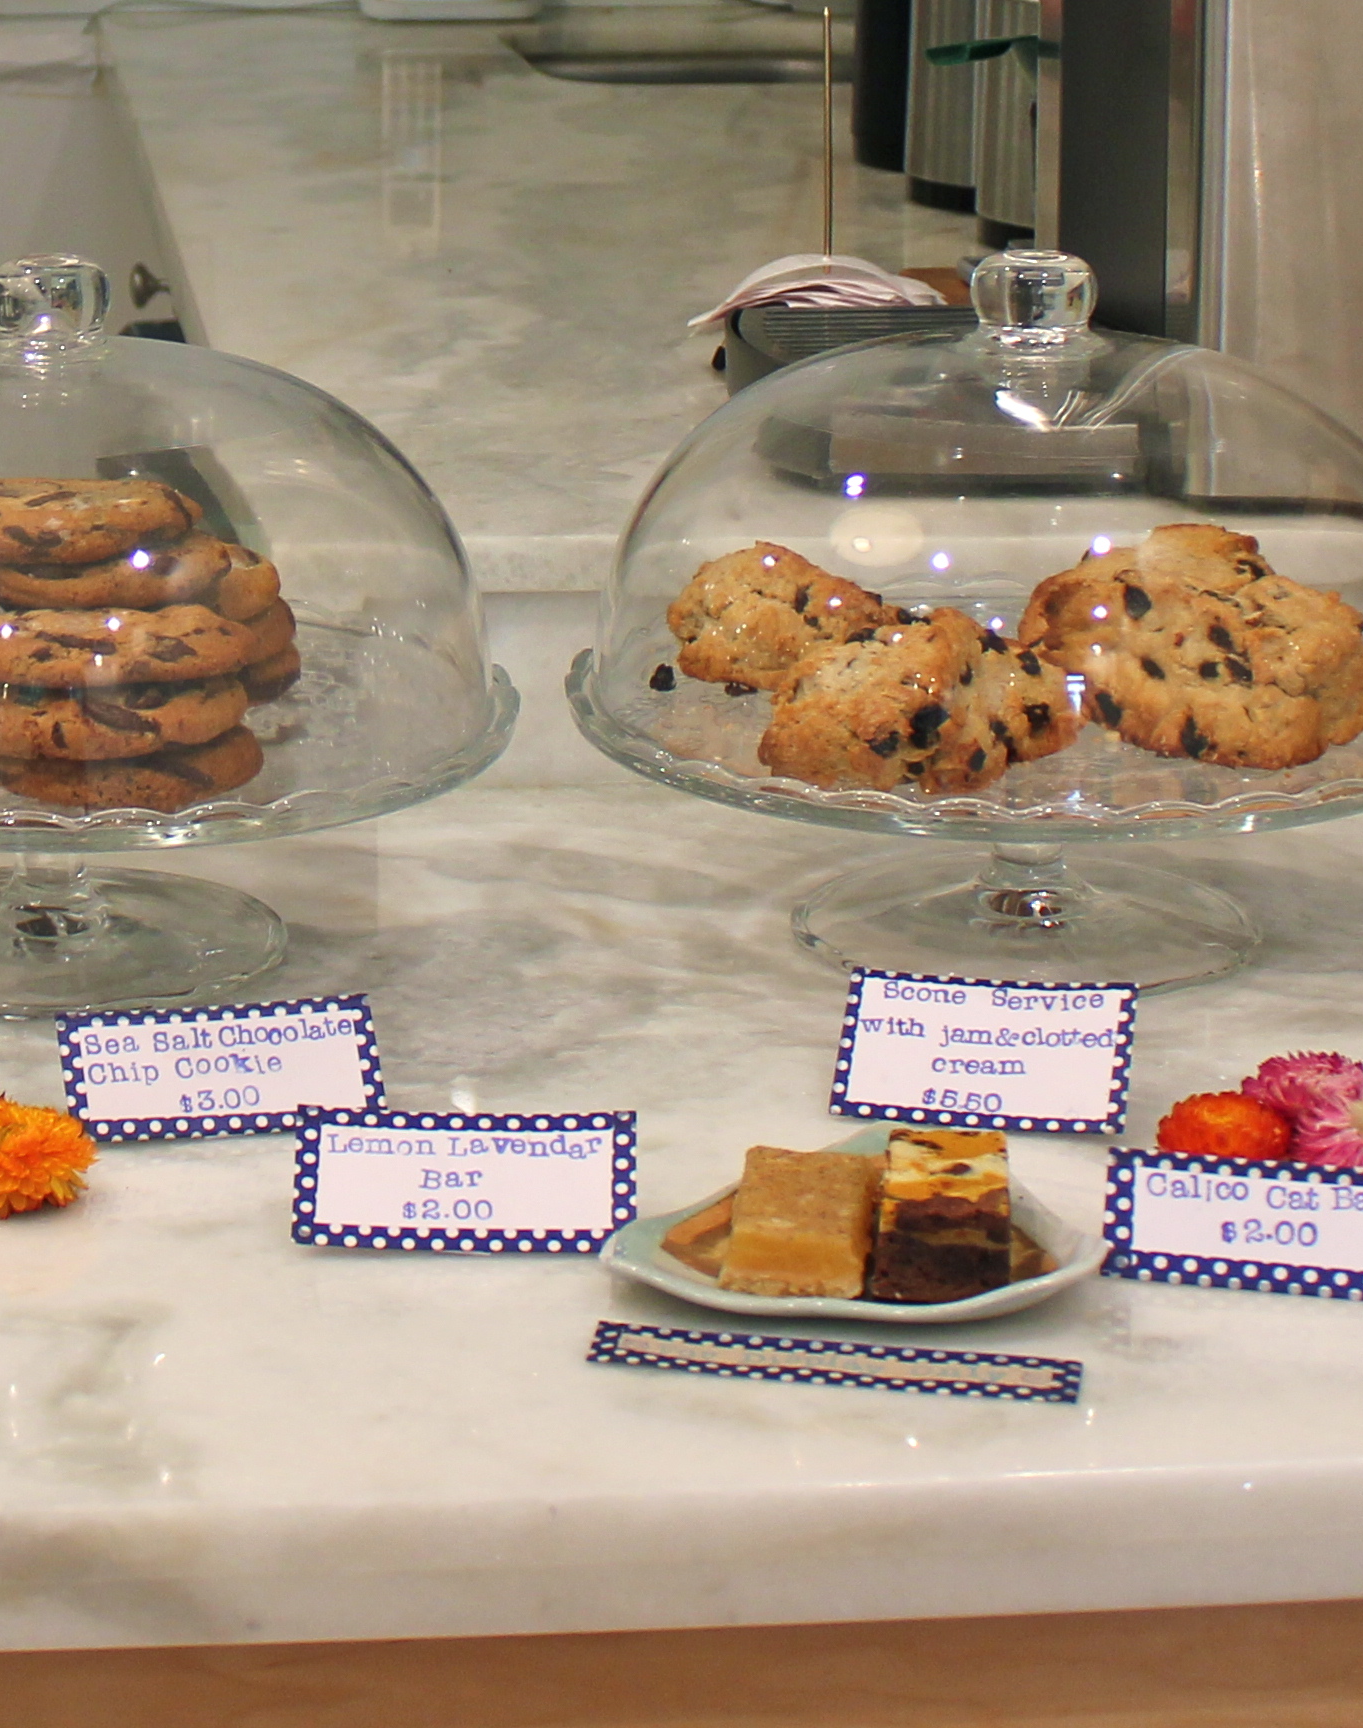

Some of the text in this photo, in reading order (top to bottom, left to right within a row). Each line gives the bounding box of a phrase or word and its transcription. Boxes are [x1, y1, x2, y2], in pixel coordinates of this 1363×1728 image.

[883, 980, 1105, 1011] Scone Service
[84, 1033, 139, 1056] Sea
[152, 1027, 213, 1053] Salt
[860, 1017, 926, 1038] with
[88, 1053, 283, 1085] Chip Cookie
[931, 1057, 1026, 1076] cream
[179, 1085, 260, 1114] $3.00
[327, 1133, 603, 1160] Lemon Lavendar
[419, 1168, 484, 1190] Bar
[1146, 1172, 1250, 1202] Calico
[1266, 1185, 1320, 1211] Cat
[402, 1199, 494, 1220] $2.00
[1220, 1218, 1319, 1247] $2.00
